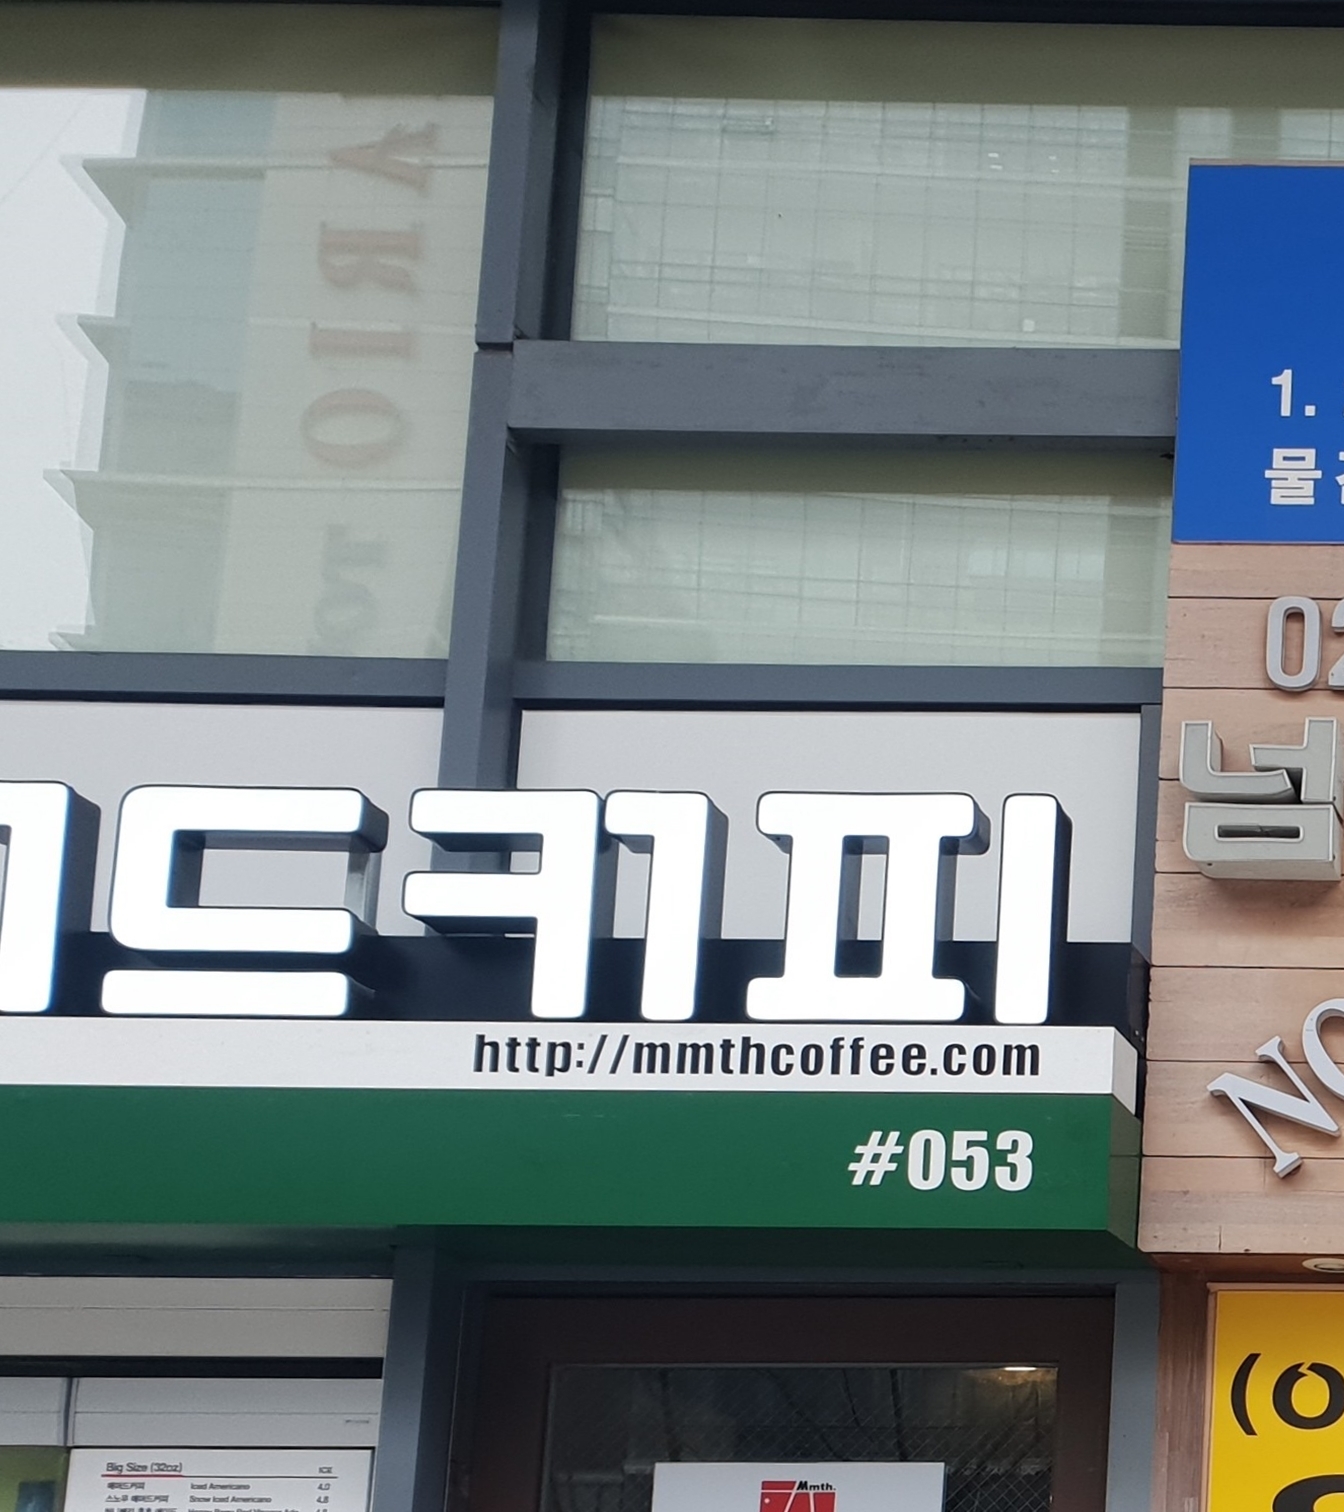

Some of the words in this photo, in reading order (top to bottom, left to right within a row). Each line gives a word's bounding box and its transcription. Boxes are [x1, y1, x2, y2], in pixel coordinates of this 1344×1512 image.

[0, 780, 1071, 1027] 드커피
[472, 1034, 1042, 1079] http://mmthcoffee.com
[847, 1130, 1035, 1191] #053
